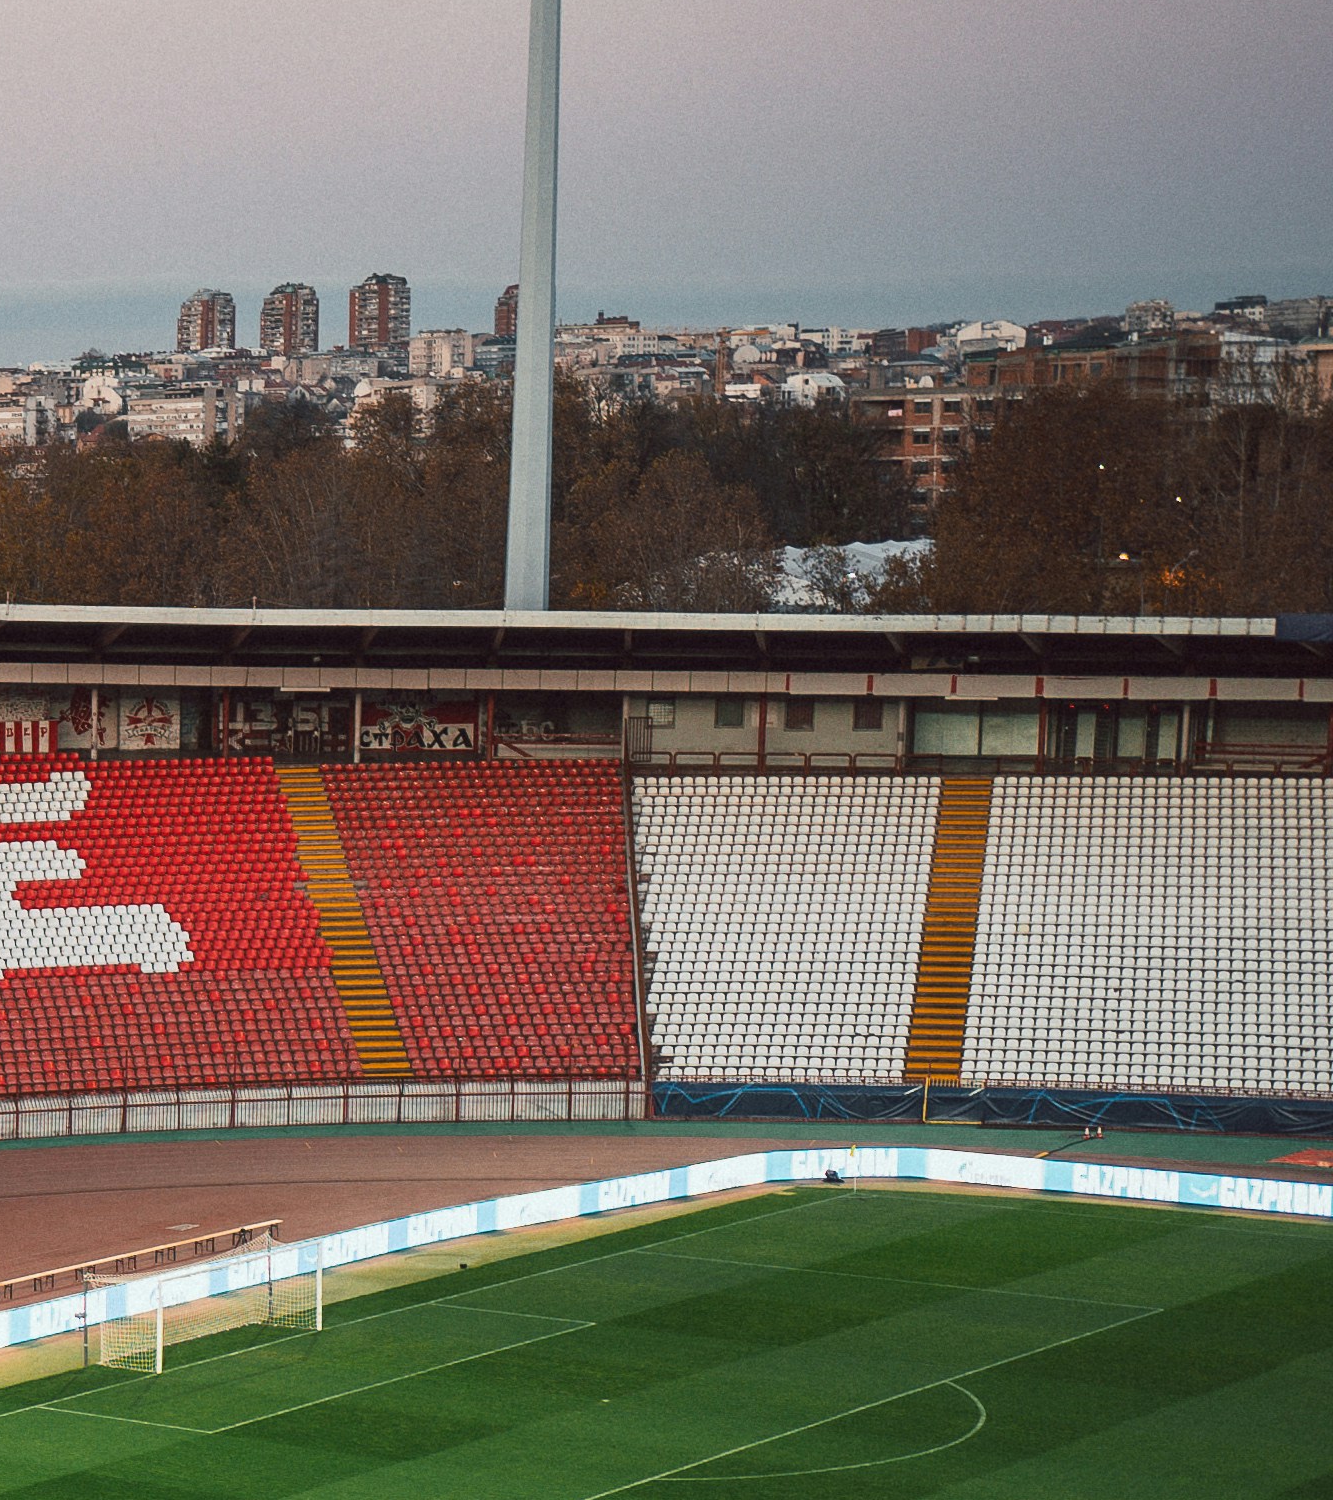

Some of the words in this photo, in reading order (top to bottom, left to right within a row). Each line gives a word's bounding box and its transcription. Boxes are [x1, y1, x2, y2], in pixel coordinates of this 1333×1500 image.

[792, 1149, 898, 1178] GAZPROM
[1073, 1164, 1180, 1201] GAZPROM
[1220, 1177, 1332, 1216] GAZPROM
